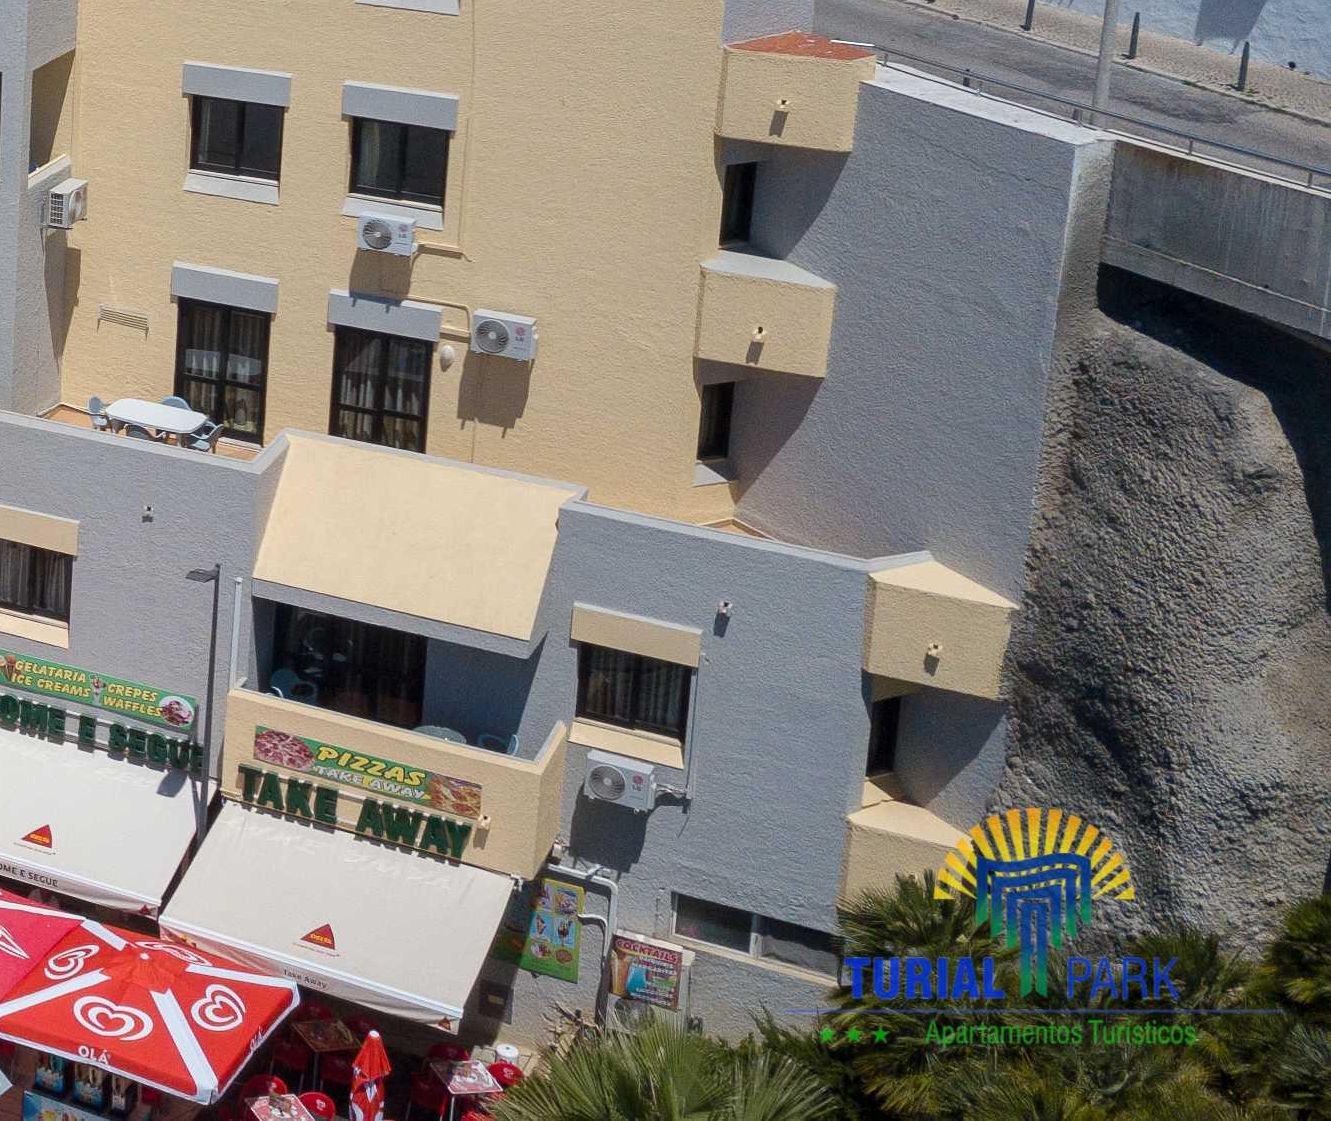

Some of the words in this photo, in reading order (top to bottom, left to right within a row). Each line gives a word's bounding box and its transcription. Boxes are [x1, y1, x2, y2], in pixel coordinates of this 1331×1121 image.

[14, 659, 87, 683] GELATARIA
[10, 672, 33, 686] ICE
[36, 677, 91, 698] CREAMS
[106, 683, 158, 702] CREPES
[102, 696, 162, 717] WAFFLES
[78, 715, 96, 747] E
[108, 723, 205, 775] SEGUE
[316, 745, 426, 787] PIZZAS
[314, 765, 365, 786] TAKE
[369, 777, 426, 800] AWAY
[238, 763, 339, 825] TAKE
[354, 797, 473, 860] AWAY
[20, 869, 26, 877] E
[27, 871, 59, 888] SEGUE
[304, 975, 327, 989] Away
[78, 1045, 109, 1065] OLÁ
